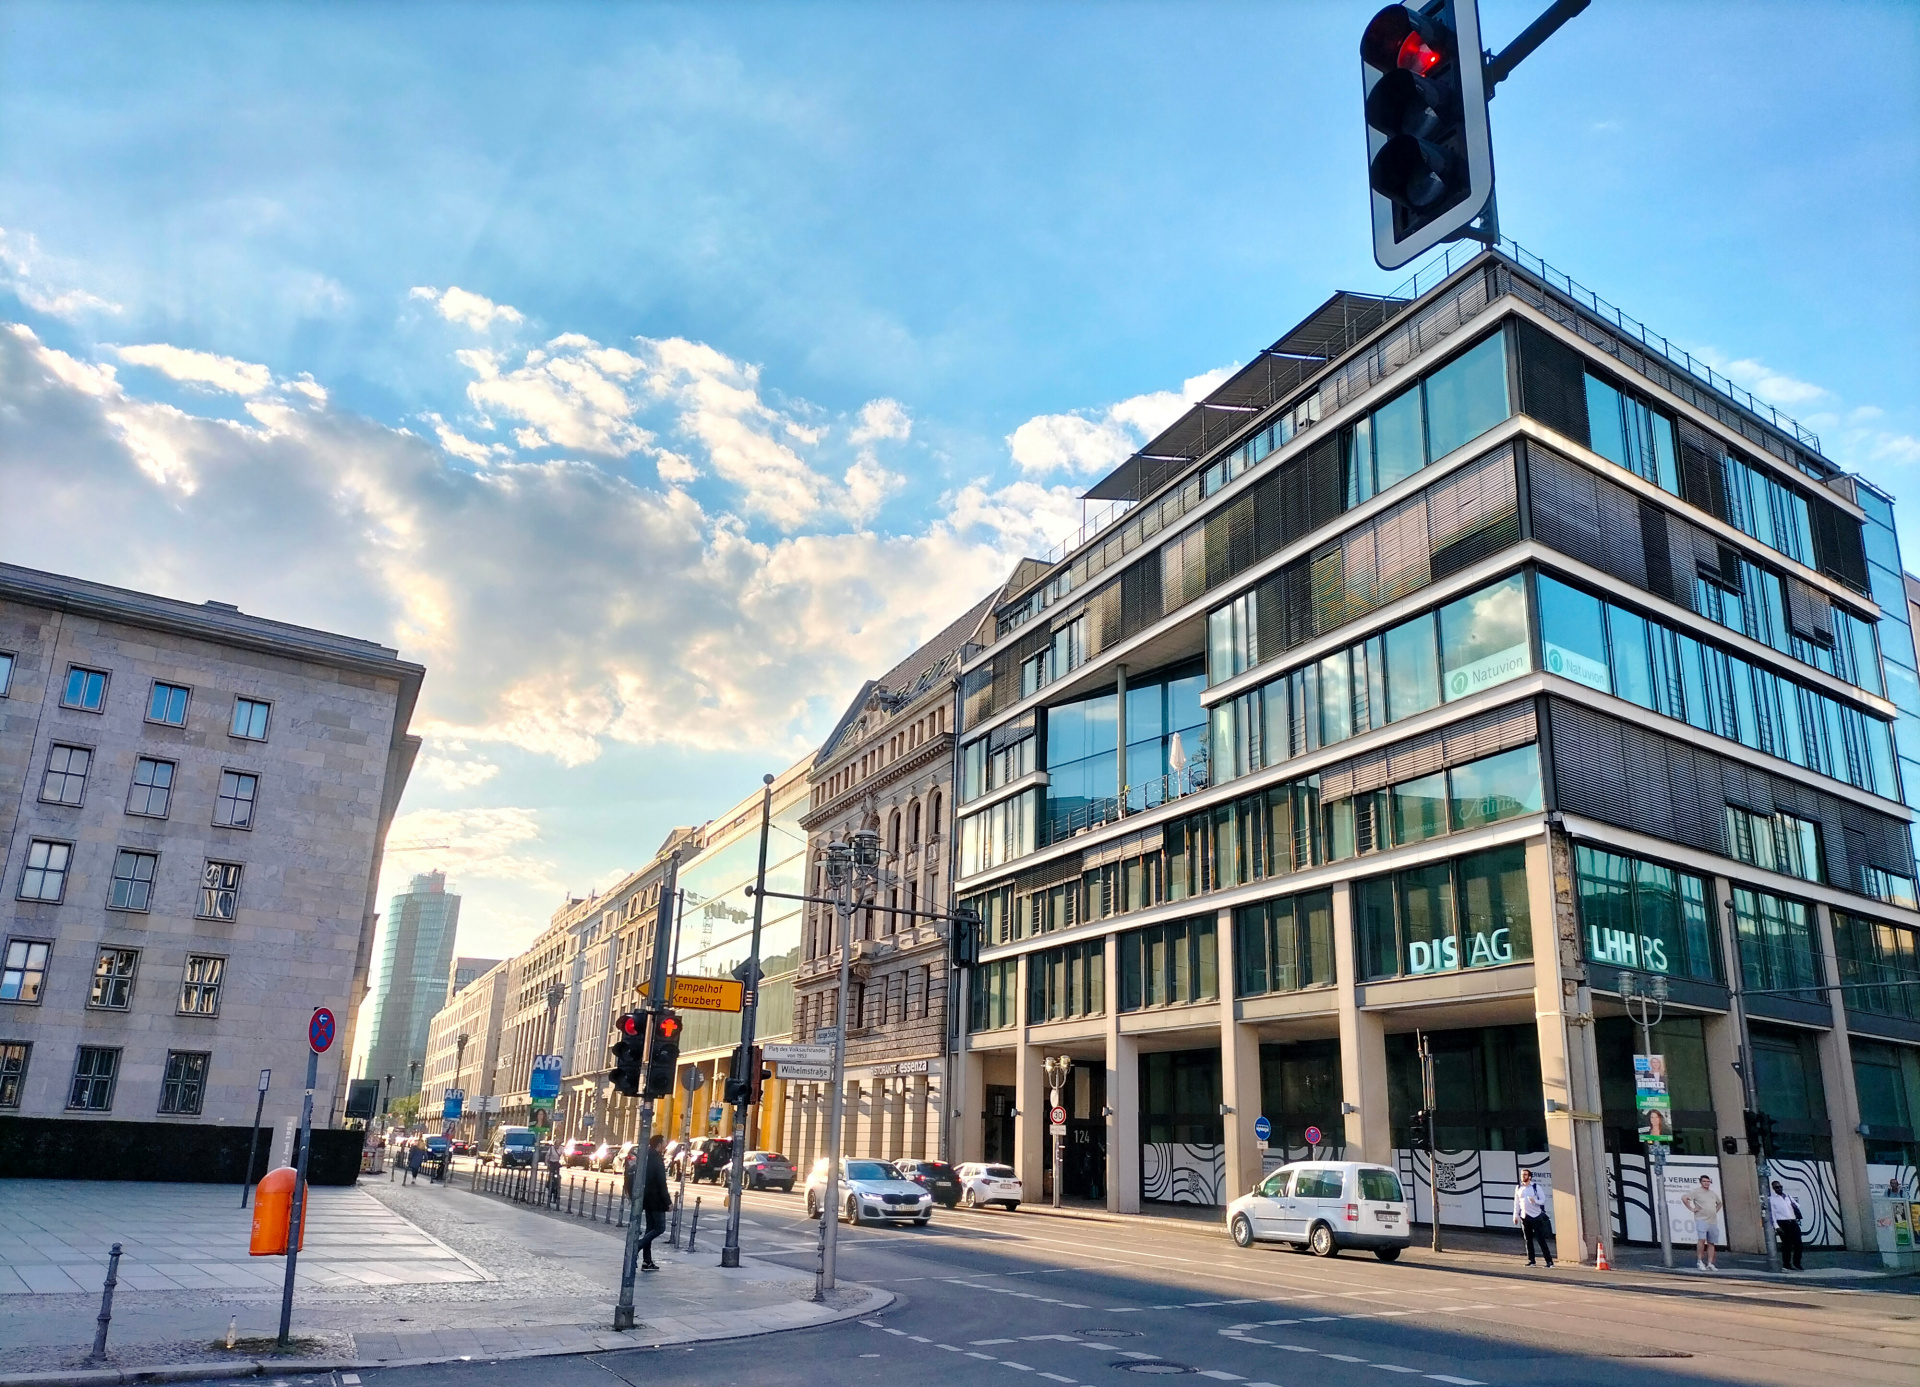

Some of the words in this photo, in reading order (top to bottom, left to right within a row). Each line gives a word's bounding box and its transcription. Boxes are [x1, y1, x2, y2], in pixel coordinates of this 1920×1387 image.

[1472, 655, 1524, 685] Natuvion
[1565, 658, 1605, 685] Natuvion
[1459, 795, 1516, 820] Adina
[1409, 936, 1456, 974] DIS
[1470, 927, 1512, 966] AG
[674, 981, 723, 994] Tempelhof
[673, 994, 721, 1008] Kreuzberg
[533, 1055, 564, 1071] AfD
[900, 1060, 928, 1074] essenza
[781, 1065, 828, 1078] Wilhelmstraße
[445, 1089, 465, 1099] AfD
[1053, 1111, 1063, 1120] 30
[1074, 1130, 1090, 1143] 124
[1672, 1219, 1695, 1234] CO
